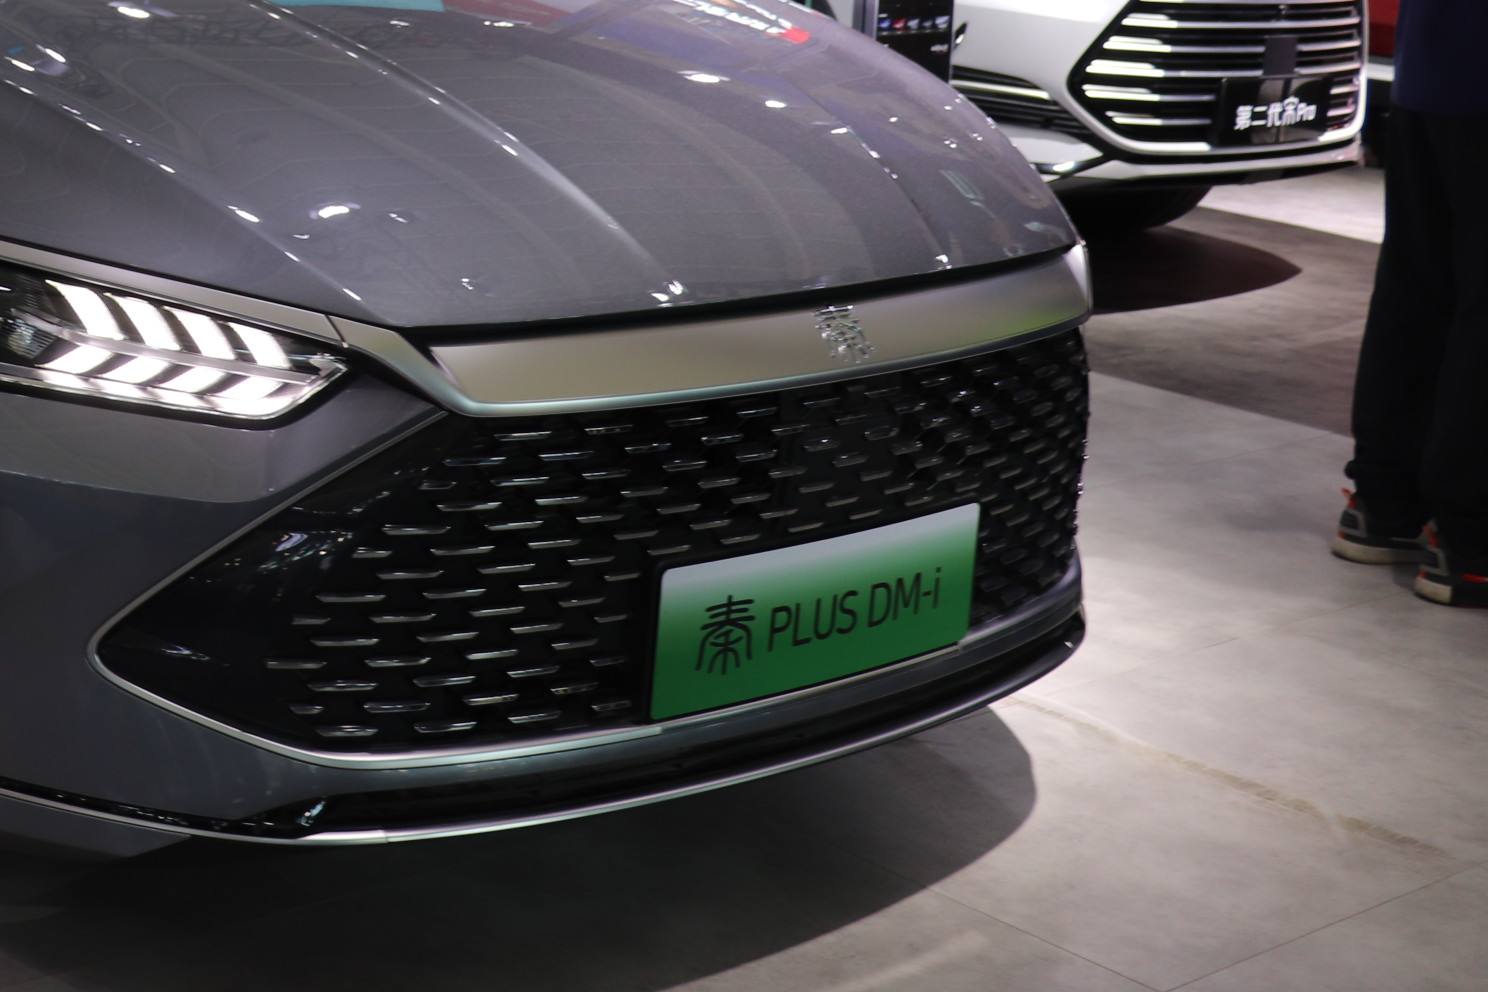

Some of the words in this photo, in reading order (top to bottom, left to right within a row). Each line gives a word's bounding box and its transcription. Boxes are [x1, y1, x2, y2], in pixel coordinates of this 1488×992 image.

[694, 594, 756, 676] 秦
[767, 589, 859, 652] PLUS
[866, 566, 942, 629] DM-i
